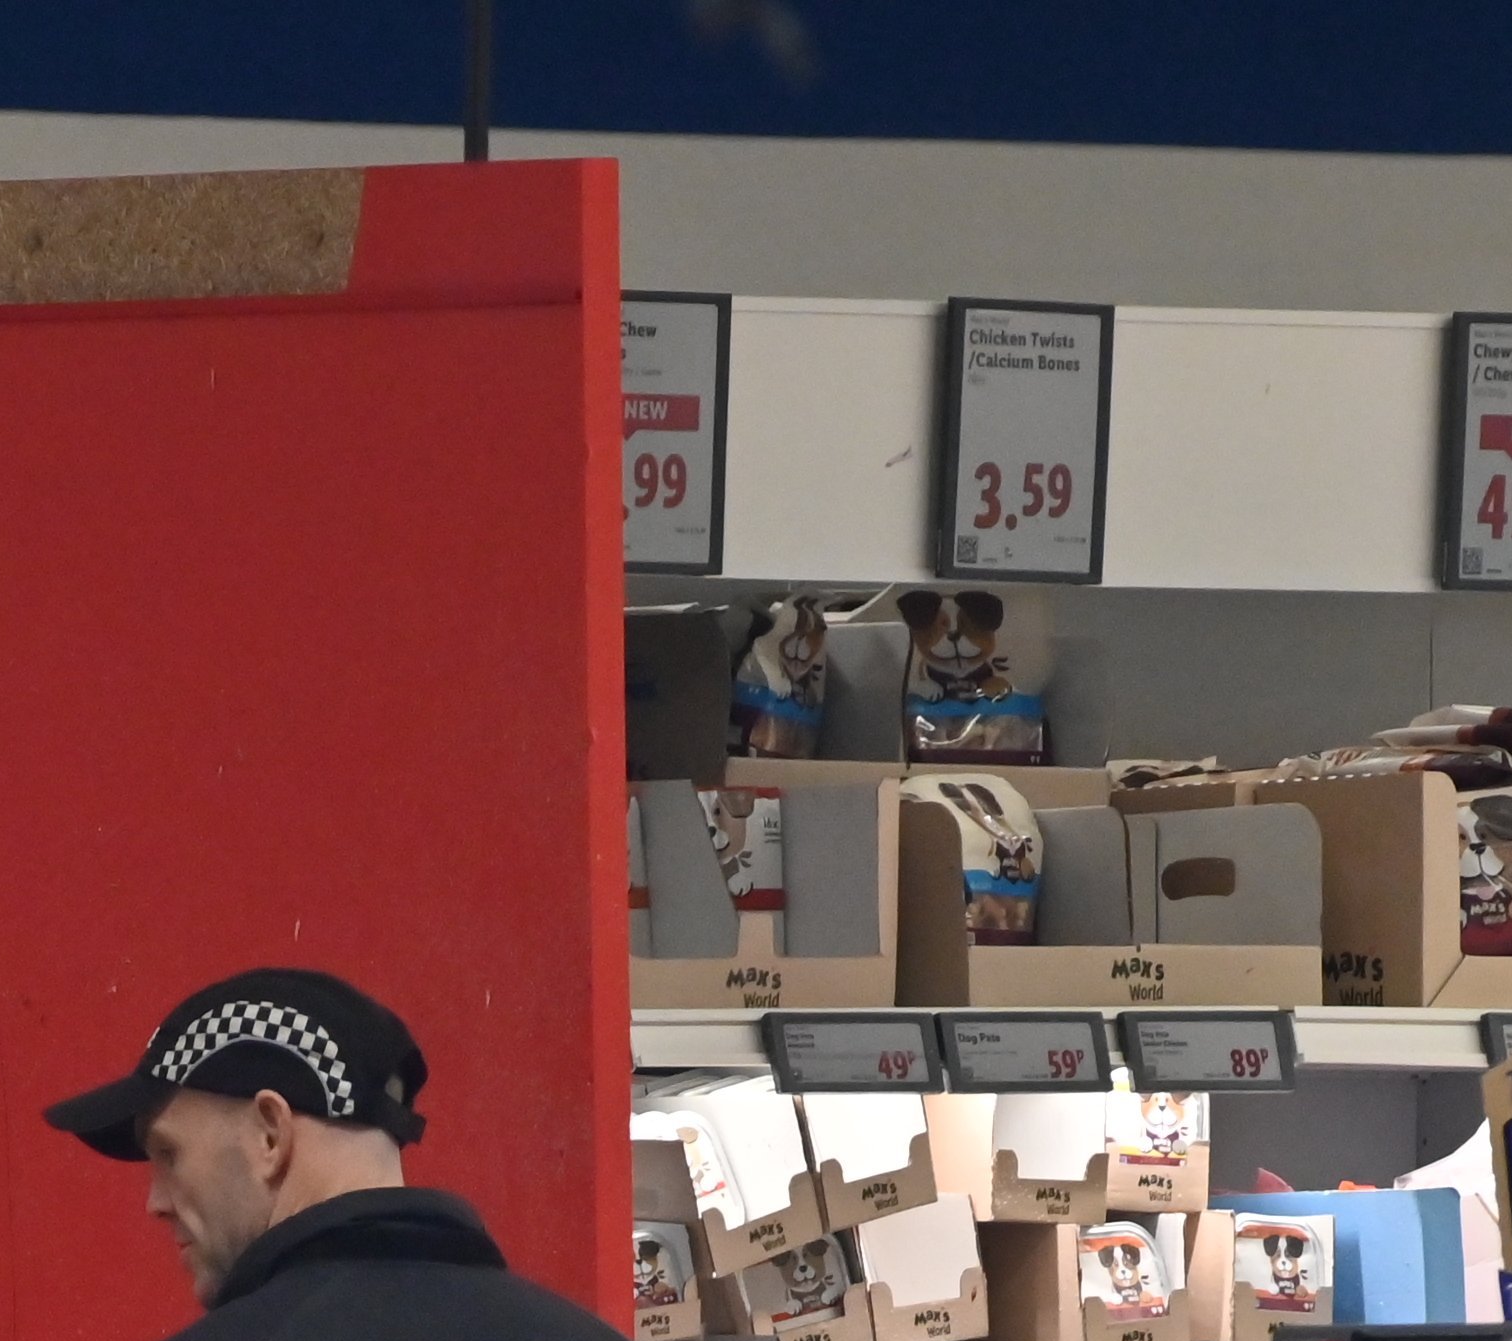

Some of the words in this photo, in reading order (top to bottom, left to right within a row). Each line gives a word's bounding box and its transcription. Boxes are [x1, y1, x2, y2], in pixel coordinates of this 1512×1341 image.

[969, 328, 1026, 347] Chicken
[1031, 331, 1075, 349] Twists
[967, 351, 1034, 370] /Calcium
[1038, 355, 1081, 372] Bones
[624, 401, 668, 420] NEW
[622, 453, 688, 521] .99
[973, 461, 1072, 531] 3.59
[1112, 958, 1164, 981] Max's
[1324, 951, 1384, 983] Max's
[726, 966, 782, 990] Max's
[743, 991, 780, 1009] World
[1128, 983, 1164, 1001] World
[862, 1182, 897, 1200] Max's
[1138, 1174, 1173, 1190] Max's
[1035, 1186, 1070, 1203] Max's
[749, 1221, 784, 1244] Max's
[640, 1313, 670, 1329] Max's
[914, 1308, 951, 1327] Max's
